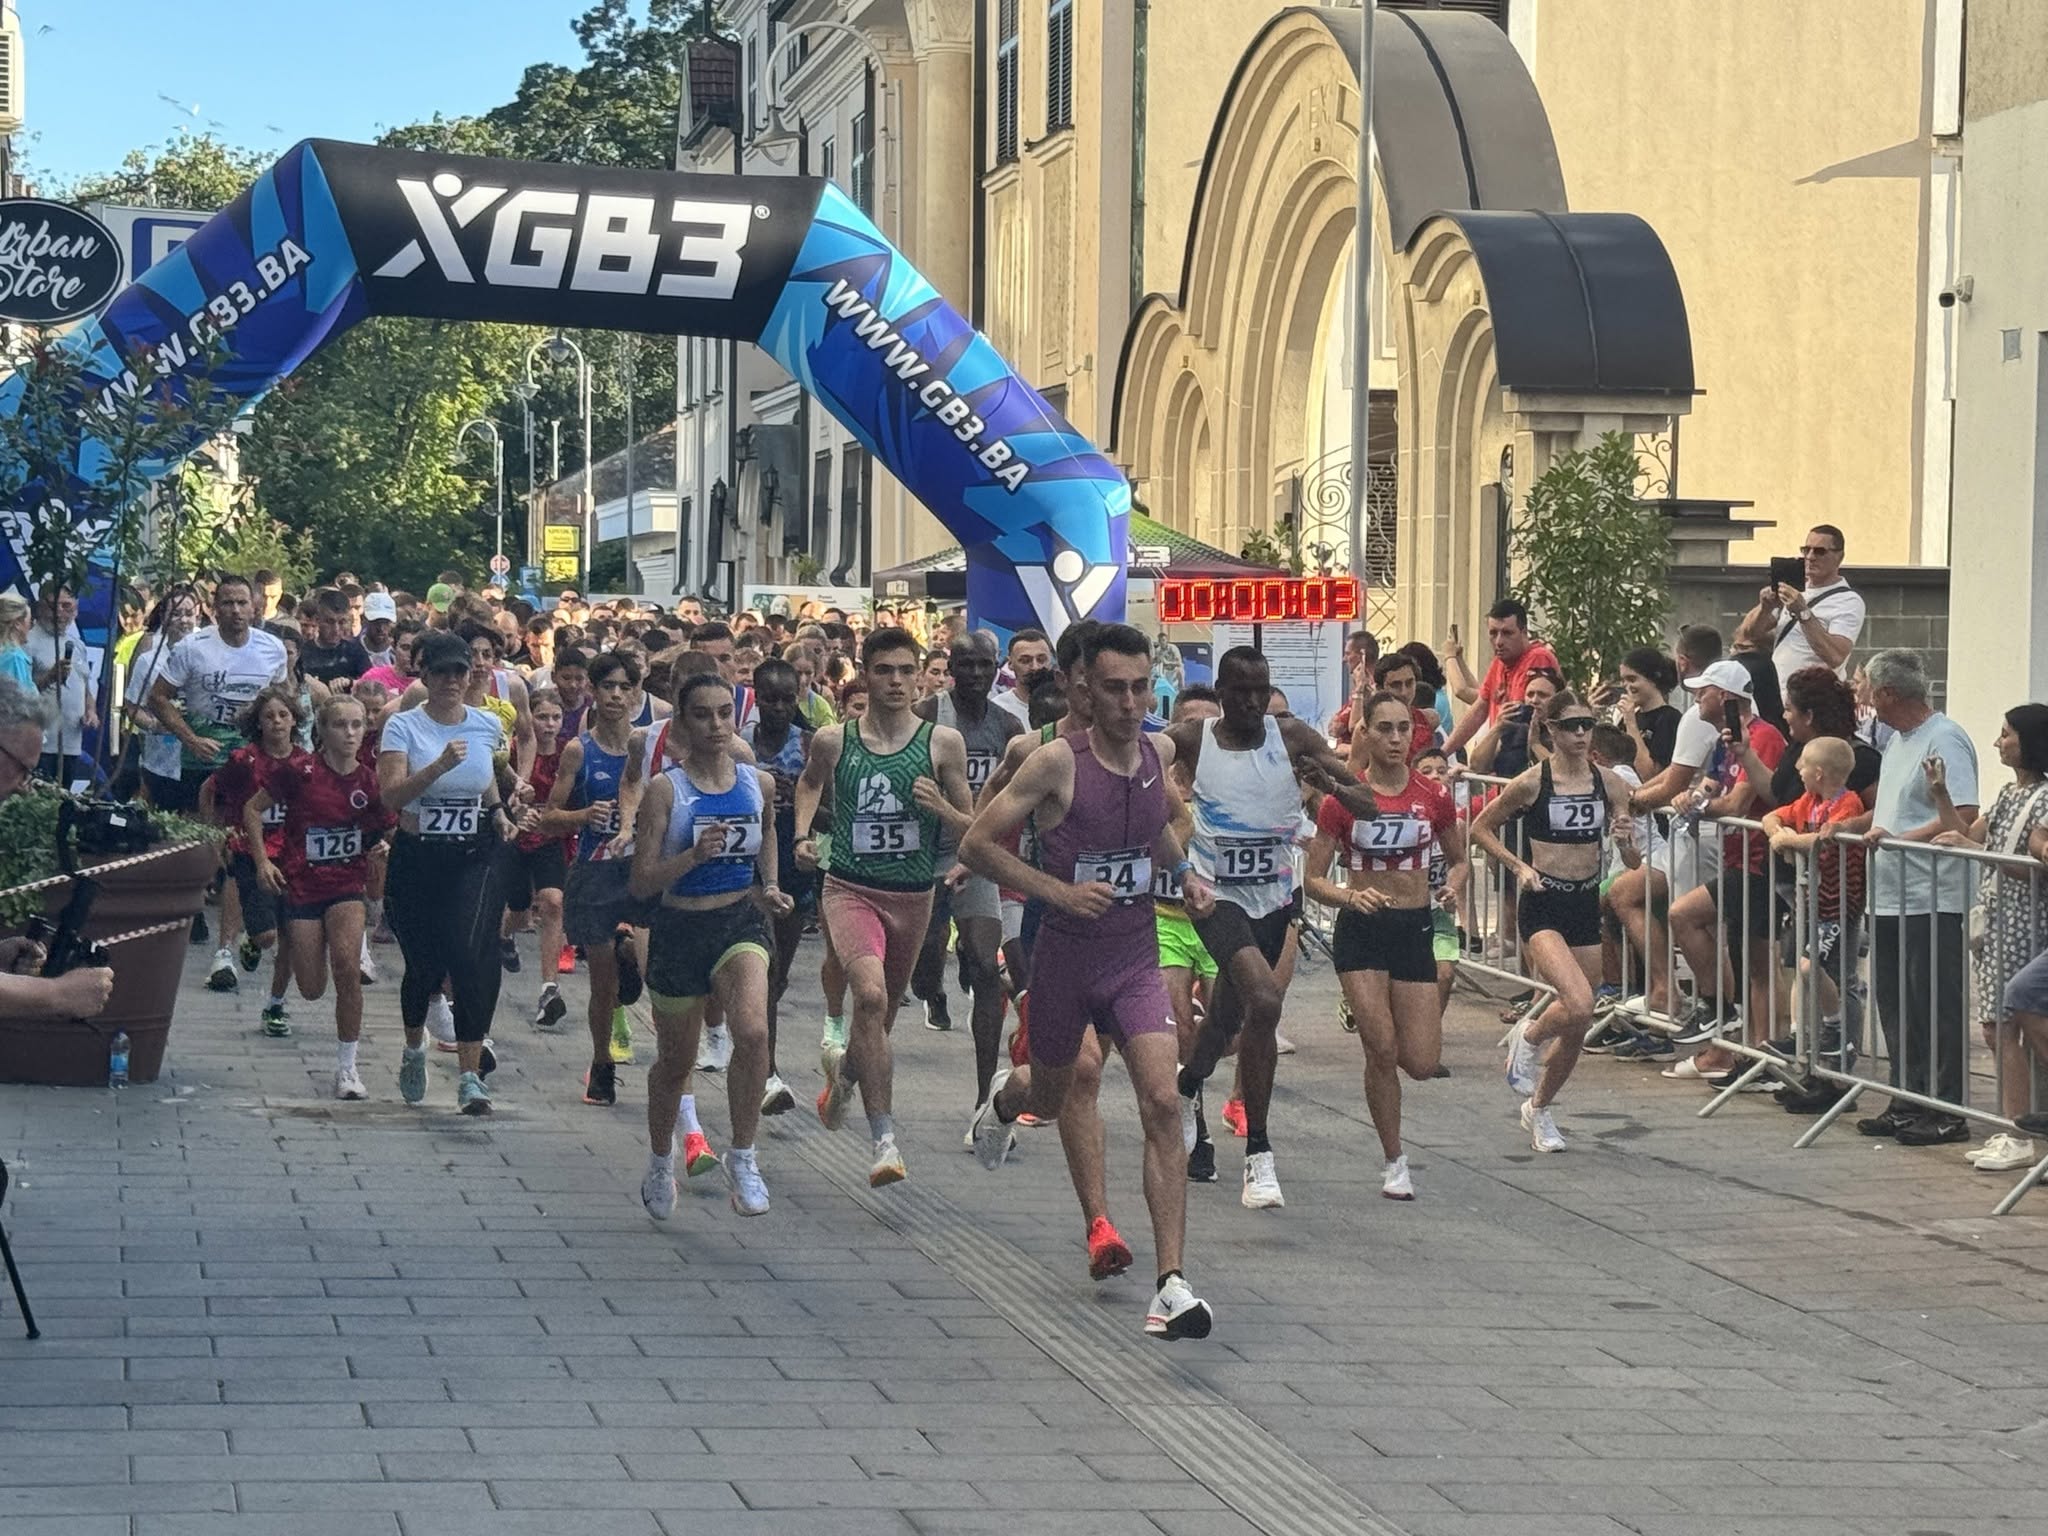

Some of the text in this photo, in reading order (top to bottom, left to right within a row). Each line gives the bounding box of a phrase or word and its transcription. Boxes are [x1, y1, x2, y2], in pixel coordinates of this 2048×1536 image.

[826, 279, 1029, 491] WWW.GB3.BA
[1161, 580, 1357, 620] 00:00:03
[967, 758, 991, 781] 01
[426, 808, 473, 832] 276
[1564, 803, 1595, 828] 29
[312, 832, 356, 858] 126
[869, 823, 905, 850] 35
[1371, 821, 1404, 846] 27
[1222, 847, 1274, 875] 195
